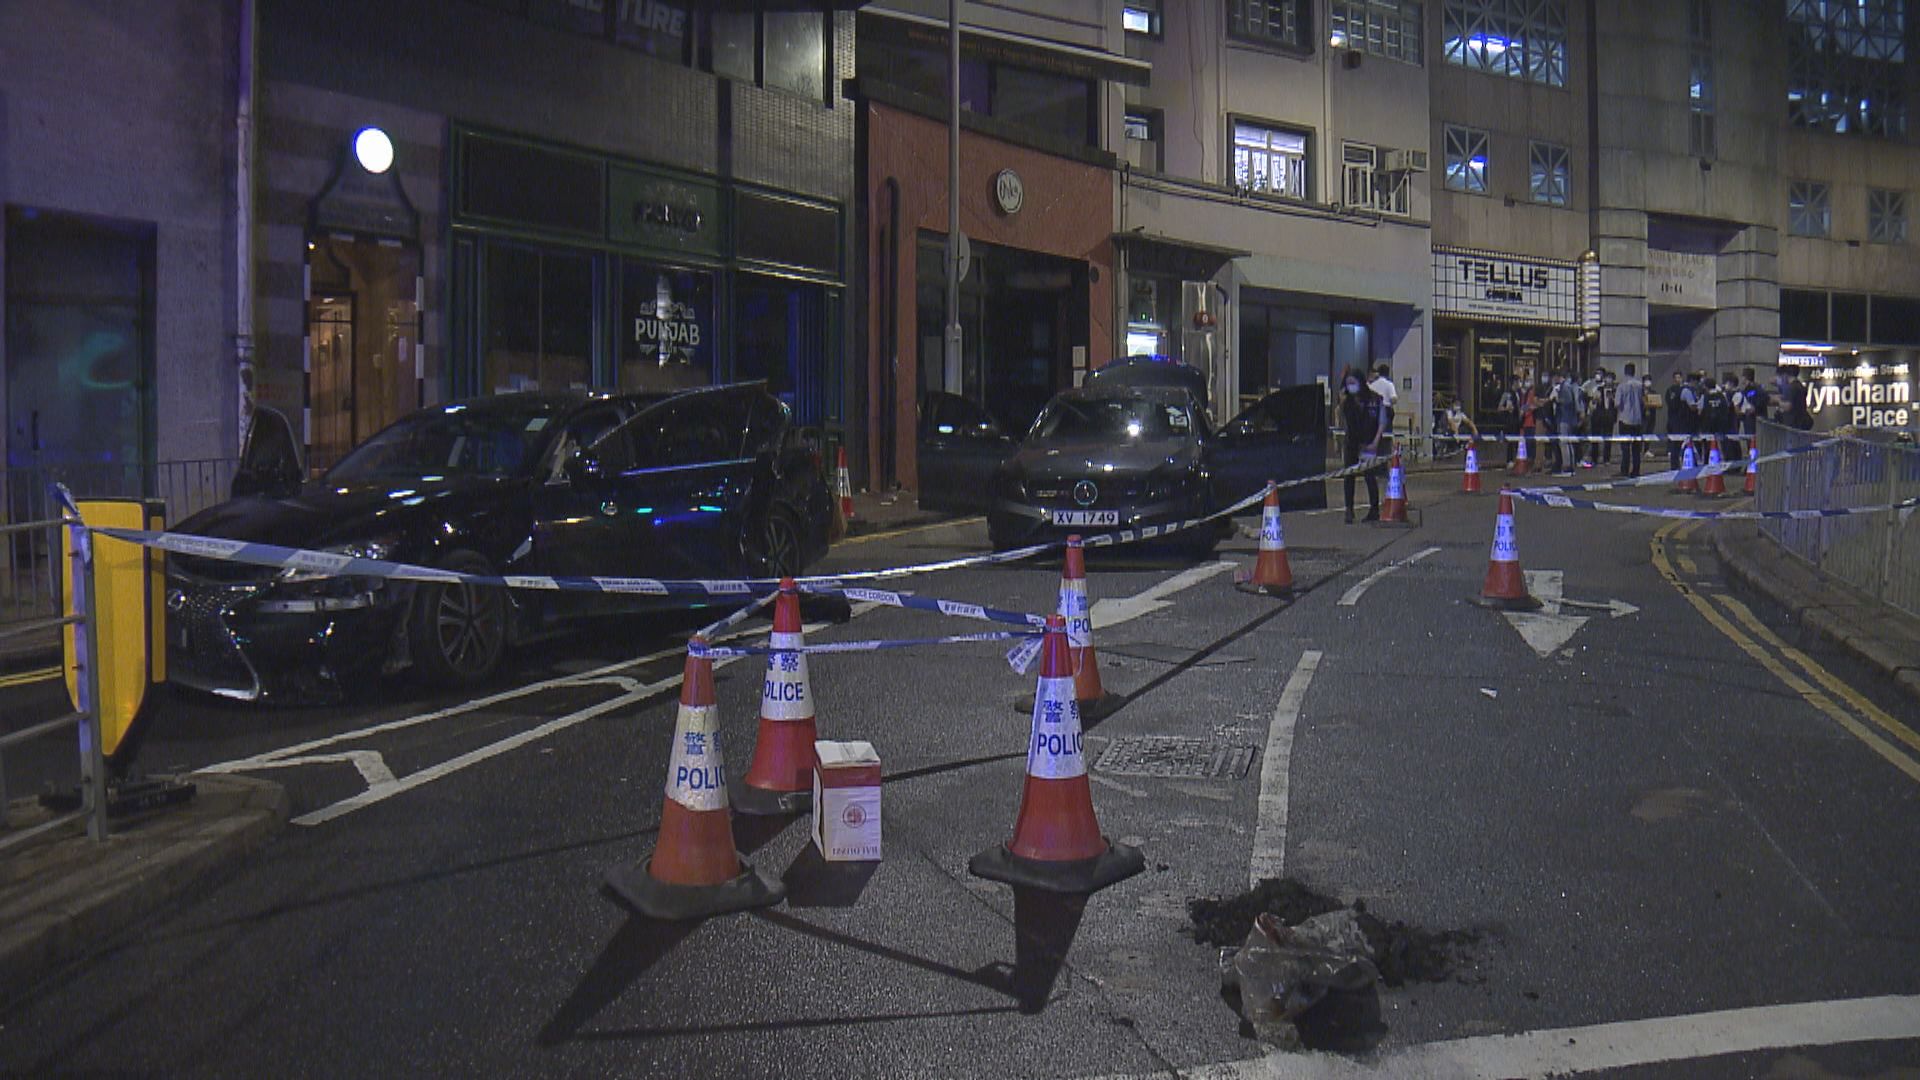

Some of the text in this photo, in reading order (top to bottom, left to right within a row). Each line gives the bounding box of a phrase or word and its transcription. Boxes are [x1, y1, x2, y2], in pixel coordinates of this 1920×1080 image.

[1458, 260, 1547, 289] TELLUS
[634, 317, 701, 345] PUNJAB
[1852, 406, 1908, 428] Place
[1057, 511, 1115, 523] XV 1749
[1037, 732, 1084, 756] POLIC
